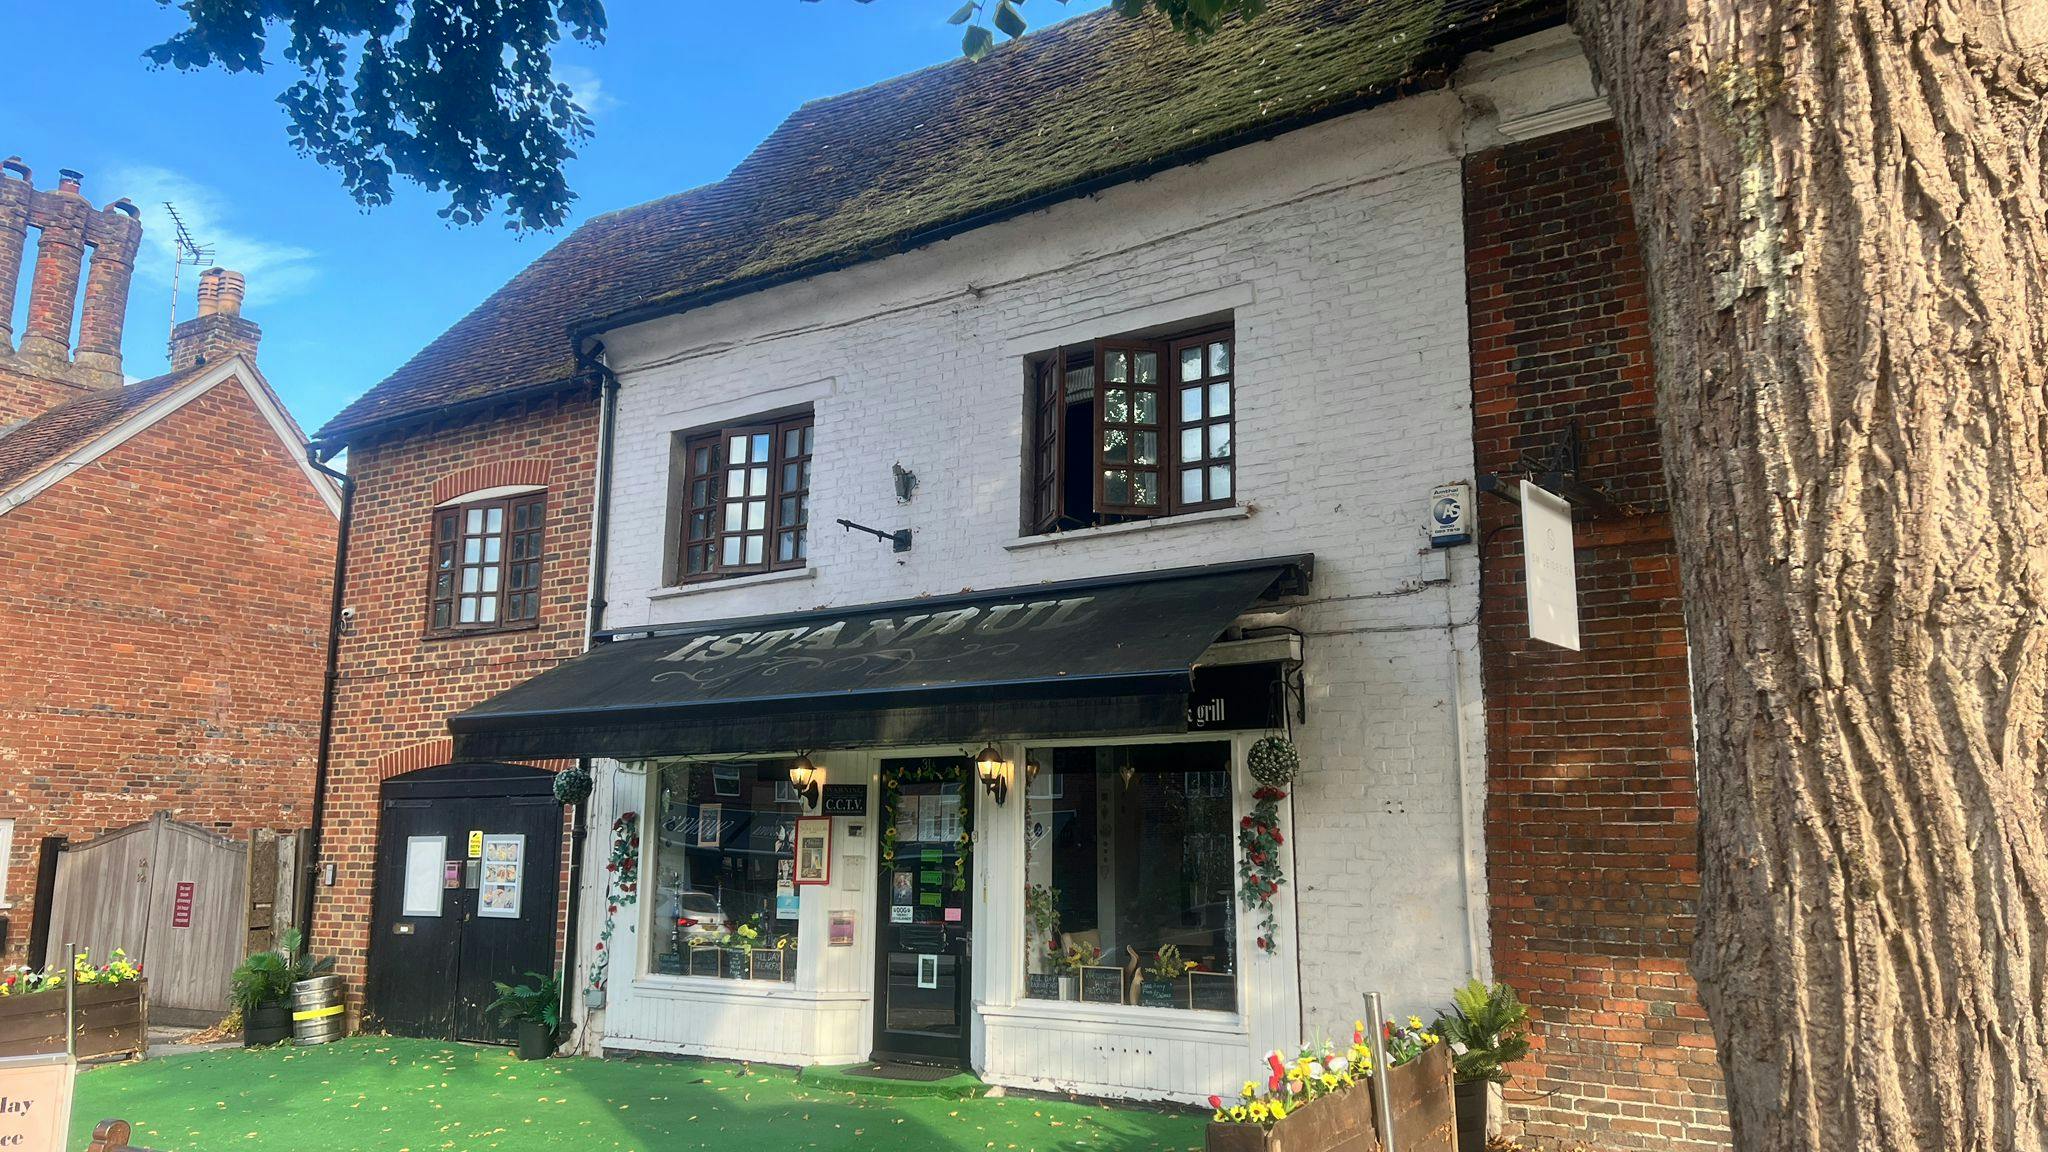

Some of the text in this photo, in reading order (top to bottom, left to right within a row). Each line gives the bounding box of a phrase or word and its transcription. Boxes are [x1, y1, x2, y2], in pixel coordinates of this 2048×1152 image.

[656, 597, 1096, 662] ISTANBUL
[1197, 698, 1225, 727] grill
[826, 799, 863, 810] C.C.T.V.
